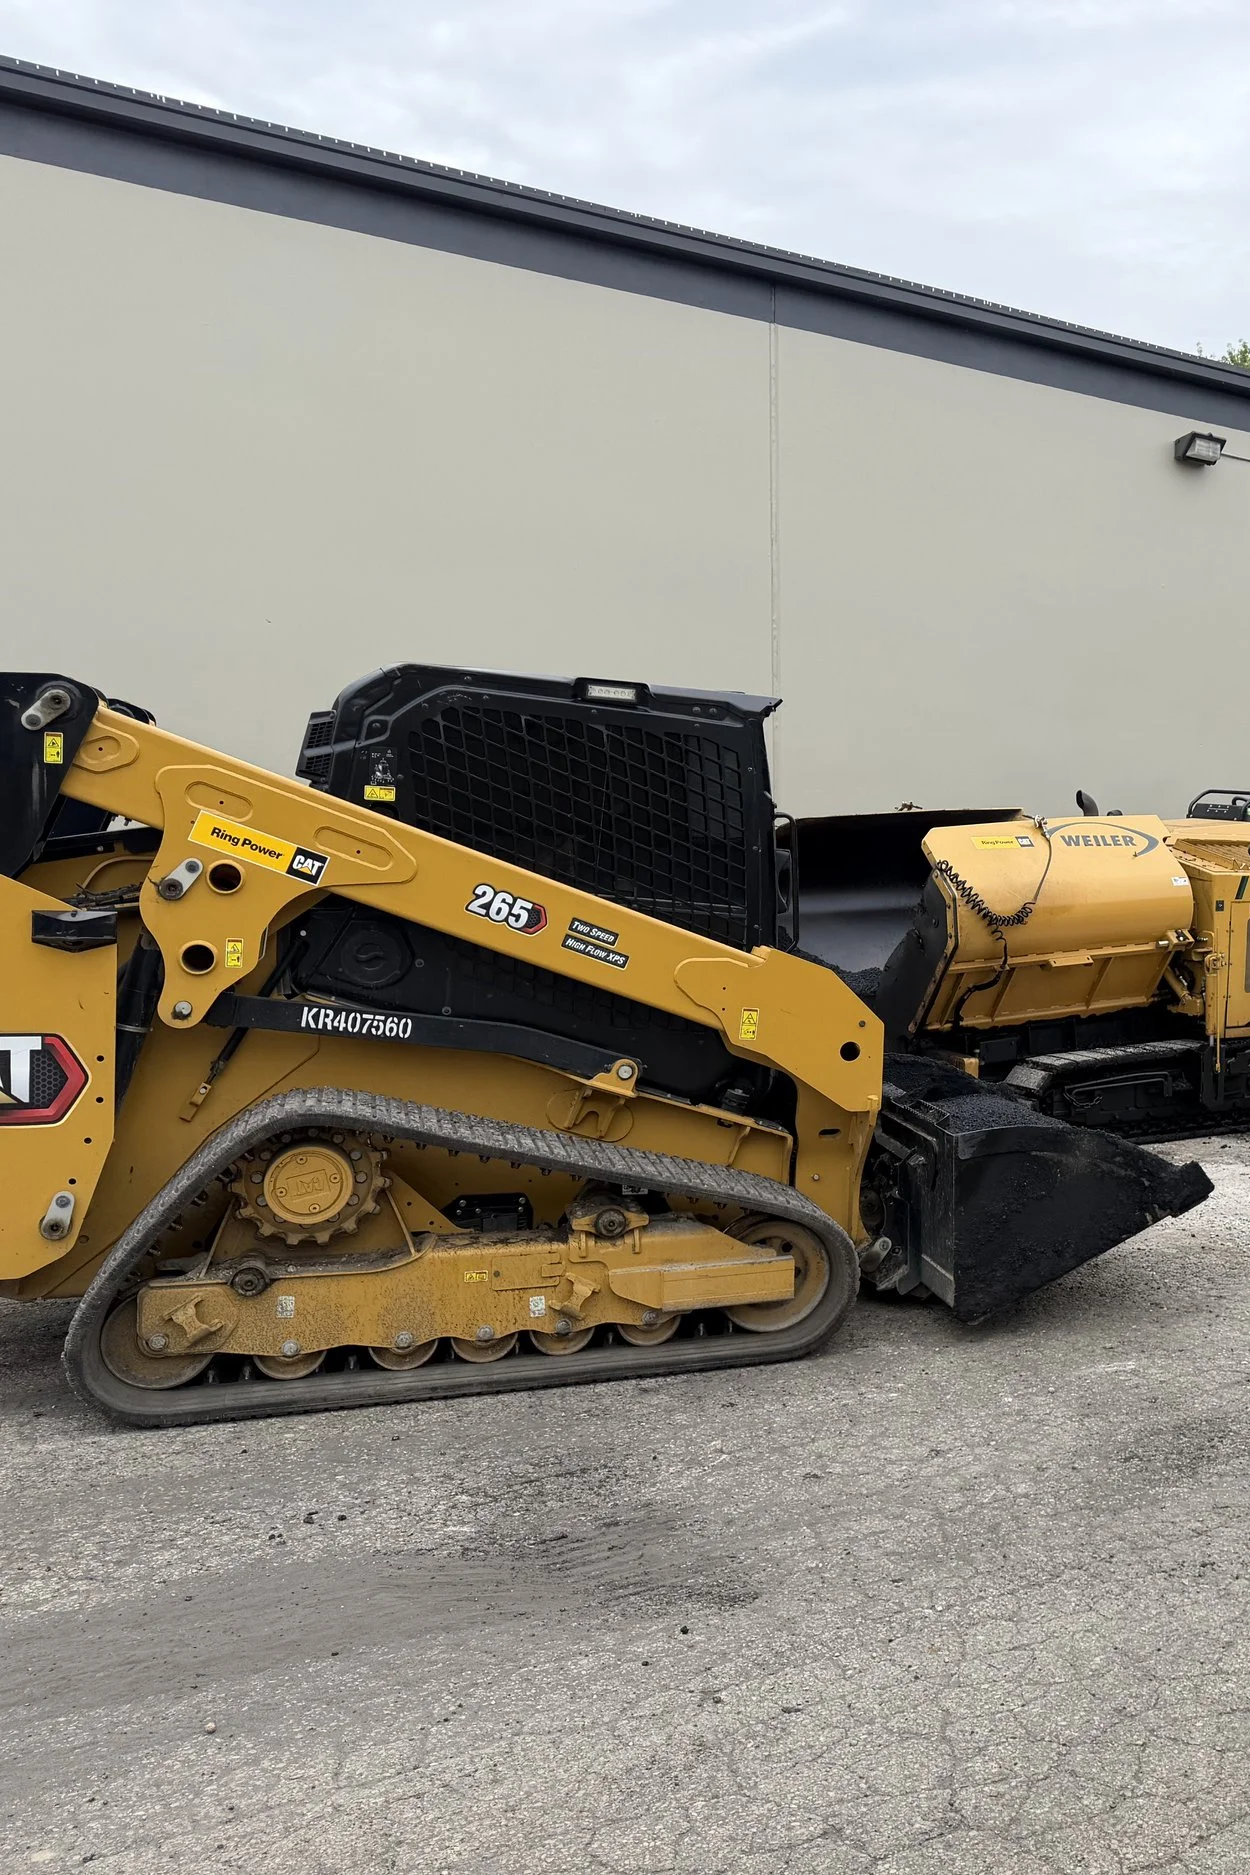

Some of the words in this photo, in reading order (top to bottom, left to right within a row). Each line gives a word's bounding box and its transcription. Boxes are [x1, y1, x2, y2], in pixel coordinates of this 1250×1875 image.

[210, 826, 240, 846] Ring
[241, 837, 283, 860] Power
[292, 855, 322, 876] CAT
[1060, 834, 1137, 847] WEILER
[467, 884, 534, 929] 265
[607, 952, 626, 965] XPS
[301, 1006, 412, 1039] KR407560
